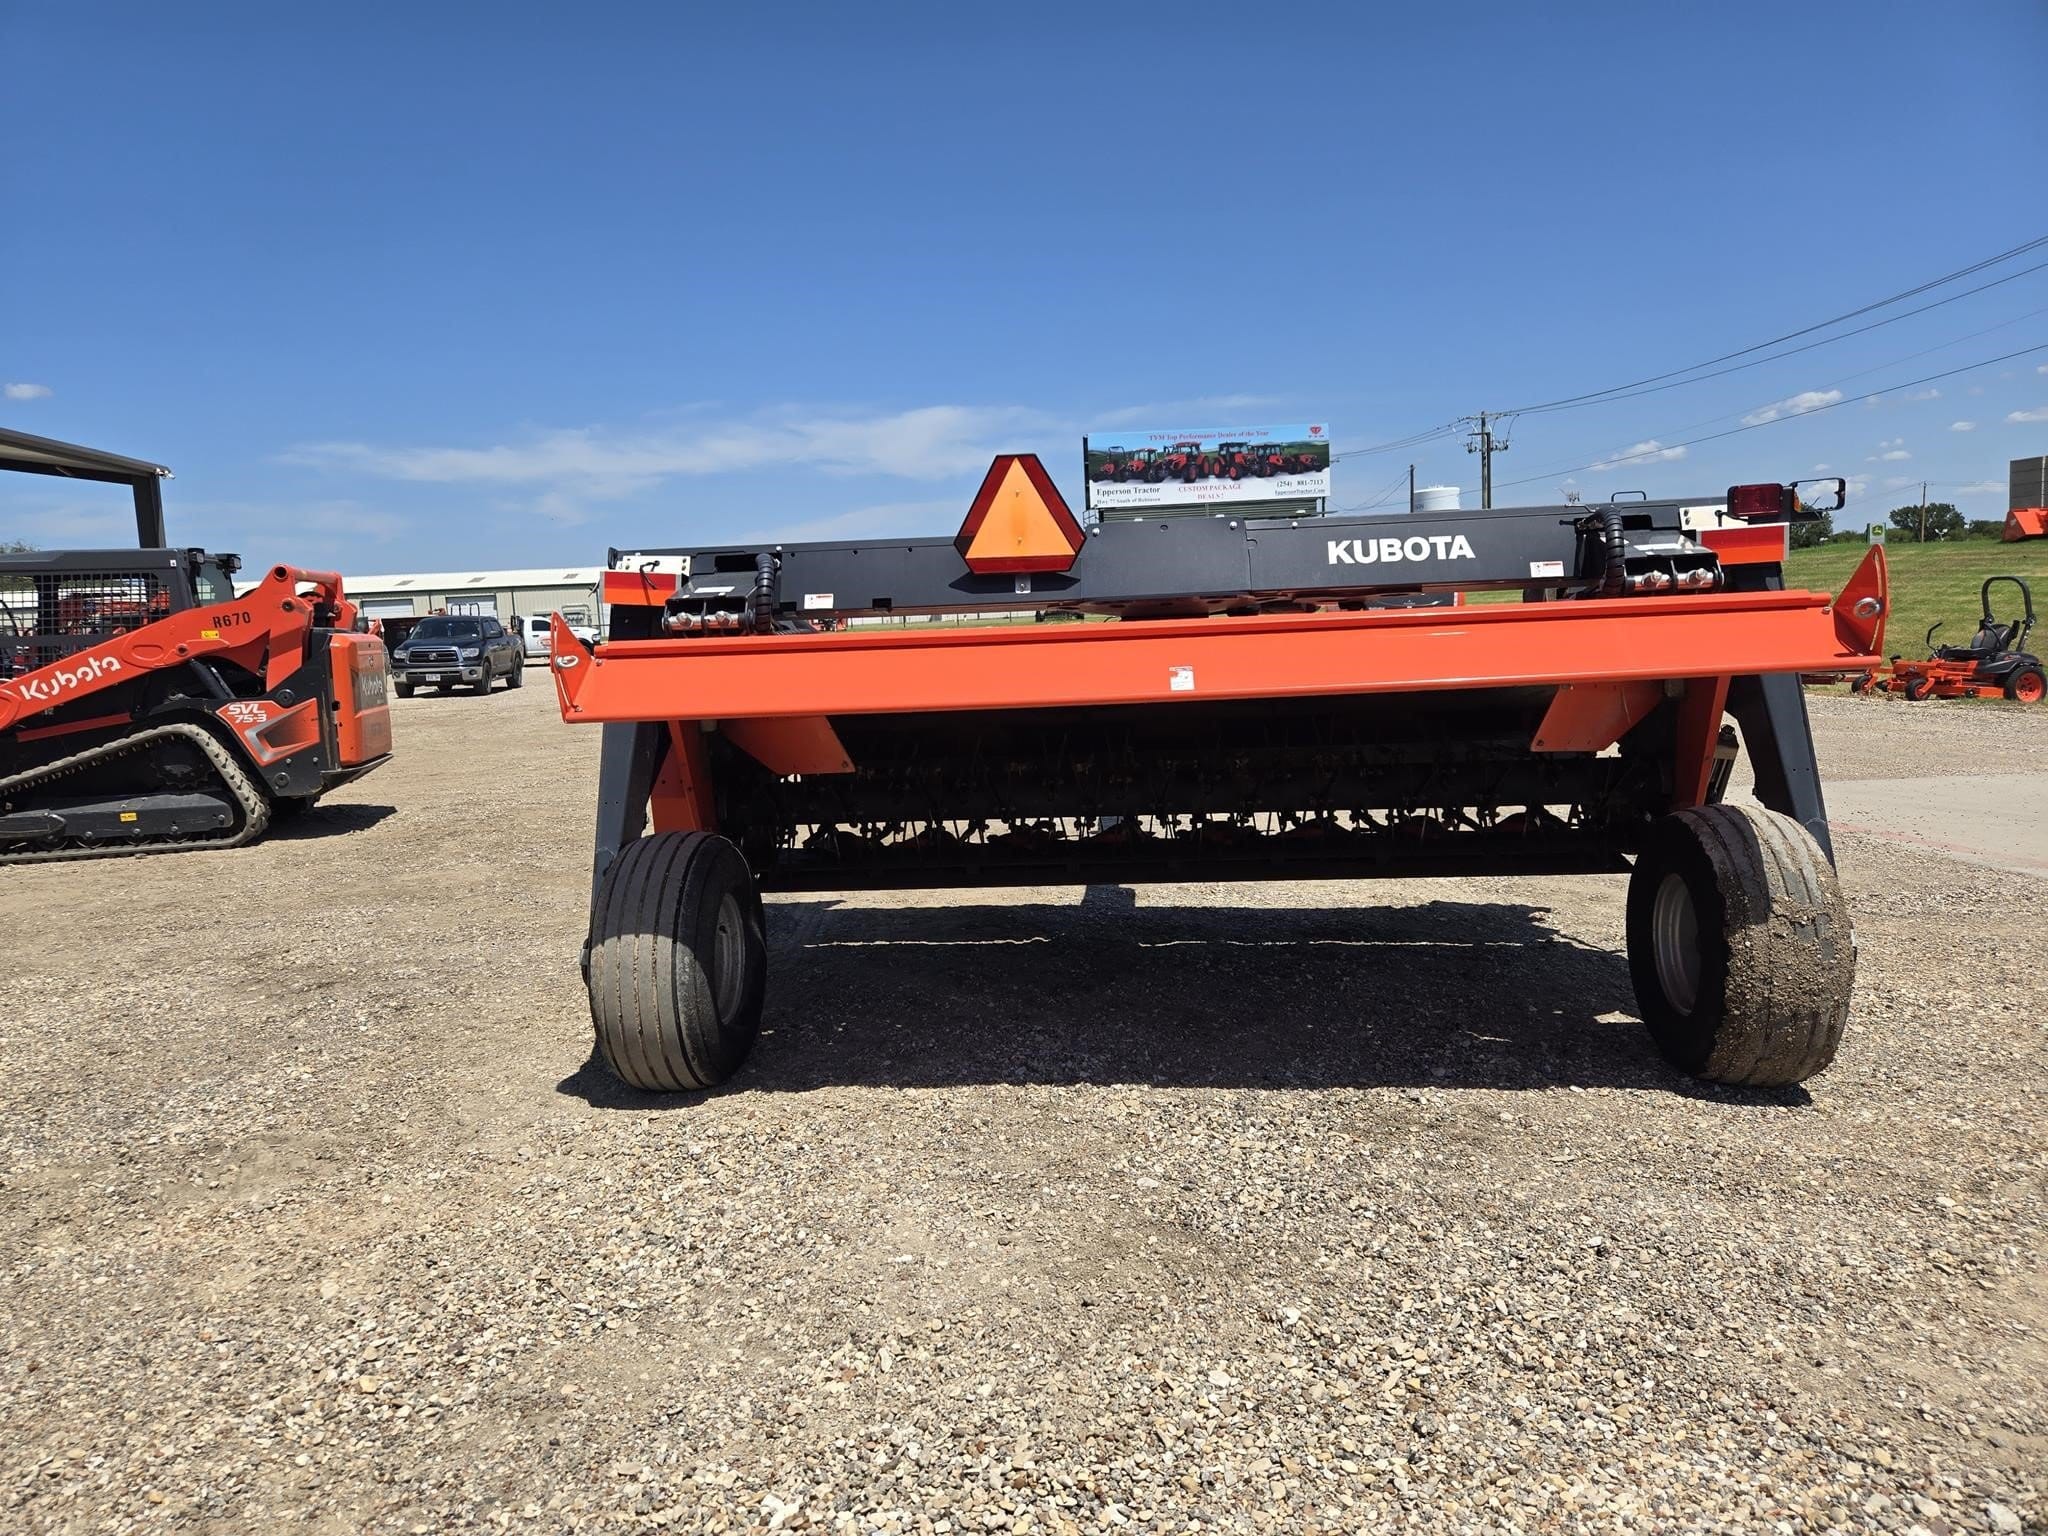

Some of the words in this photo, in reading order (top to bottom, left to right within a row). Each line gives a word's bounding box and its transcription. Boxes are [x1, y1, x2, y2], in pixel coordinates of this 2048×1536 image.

[1178, 432, 1216, 440] Performance
[1217, 431, 1236, 439] Dealer
[1209, 483, 1241, 491] PACKAGE
[1276, 480, 1292, 488] (254)
[1096, 488, 1131, 497] Epperson
[1133, 486, 1161, 494] Tractor
[1327, 535, 1476, 565] KUBOTA
[212, 611, 251, 629] R670
[20, 656, 122, 700] Kubota
[227, 703, 265, 714] SVL
[234, 713, 267, 723] 75-3
